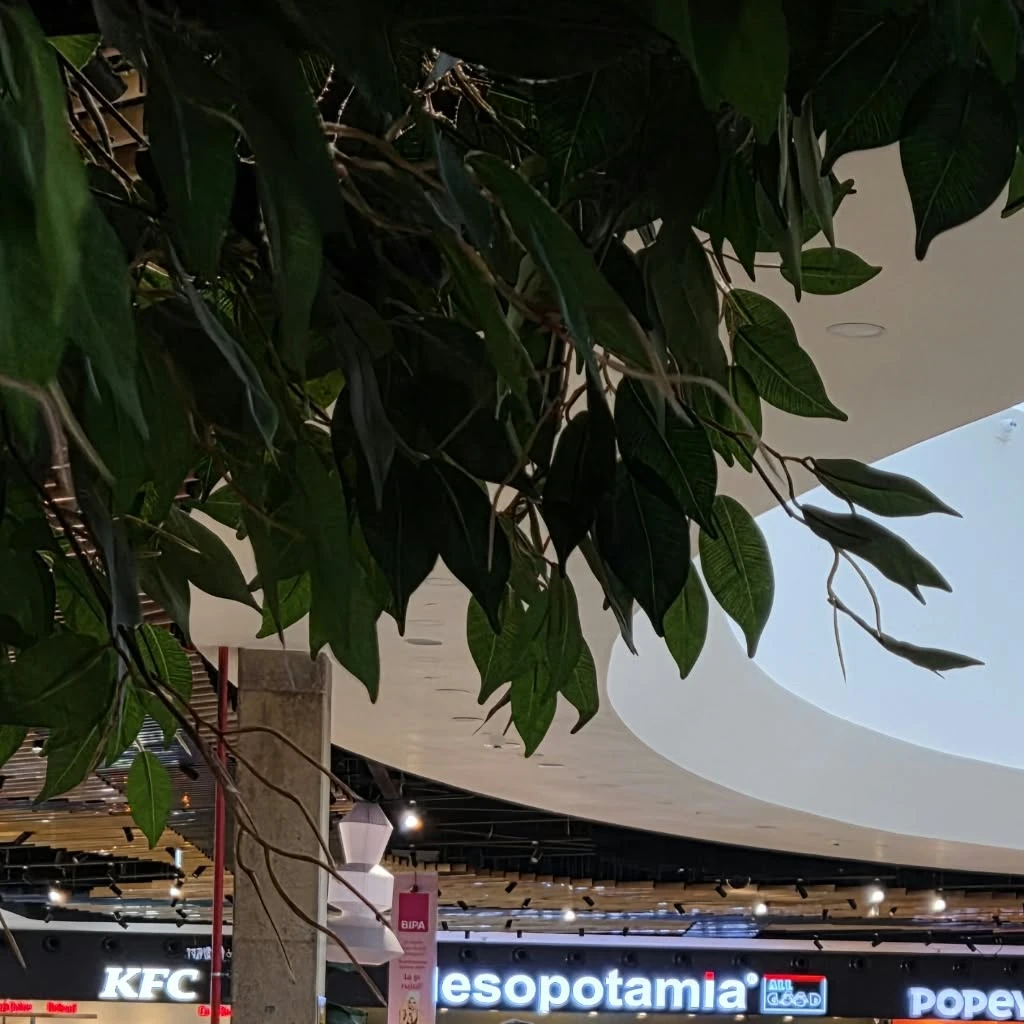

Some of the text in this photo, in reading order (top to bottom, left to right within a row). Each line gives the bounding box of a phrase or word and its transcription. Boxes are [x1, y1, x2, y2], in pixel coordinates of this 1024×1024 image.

[401, 920, 426, 930] BIPA
[98, 967, 200, 1001] KFC
[436, 969, 747, 1014] esopotamia
[768, 979, 794, 992] ALL
